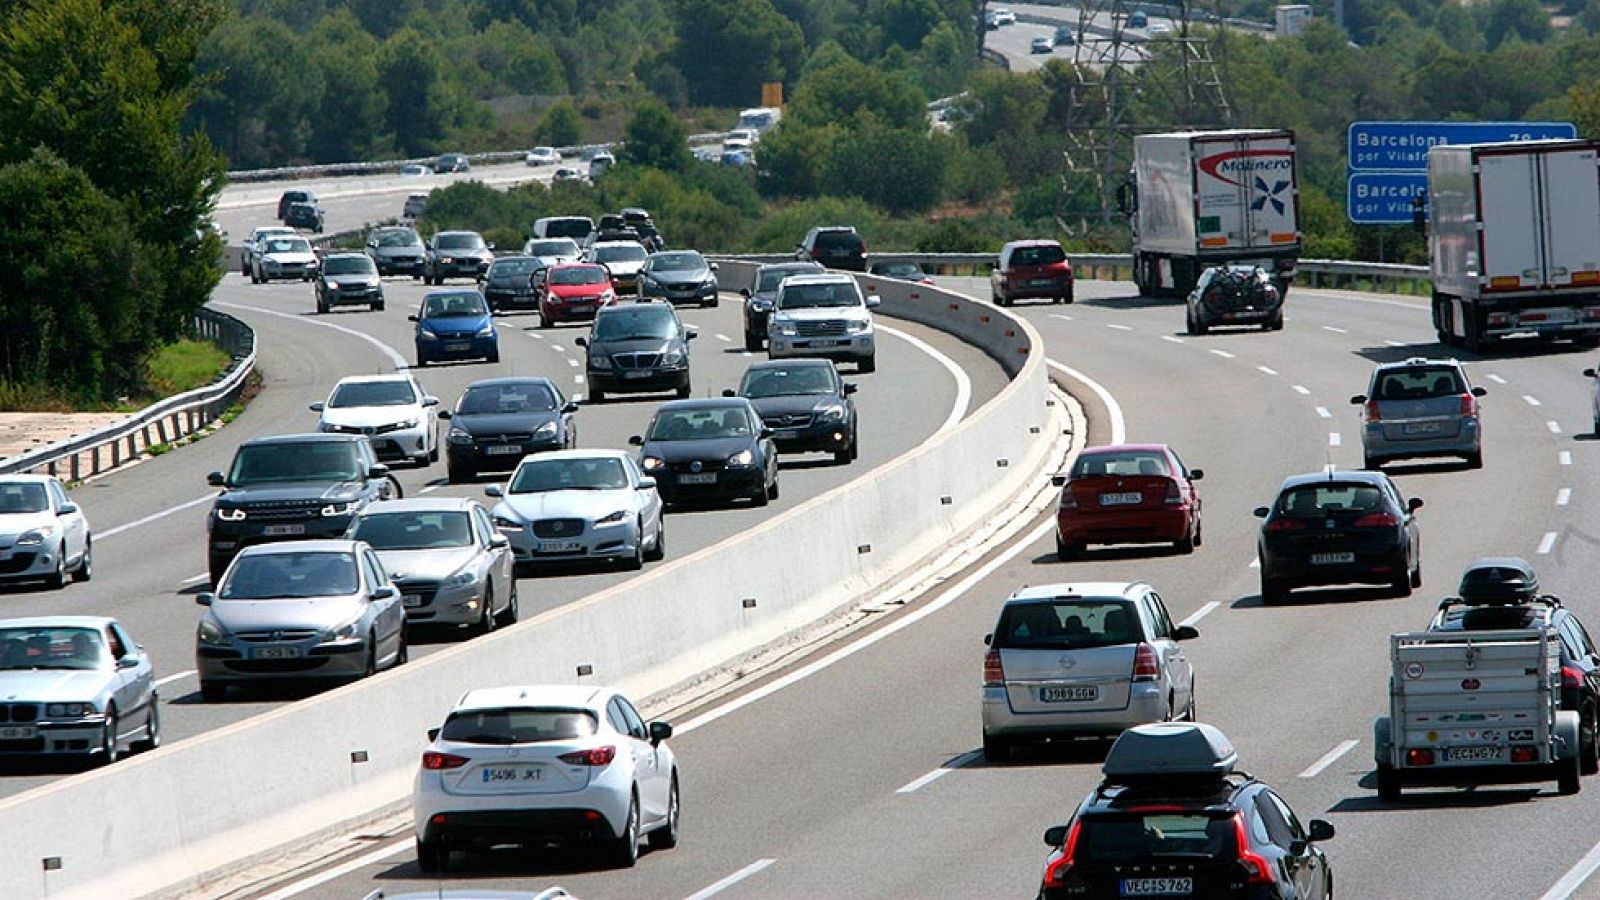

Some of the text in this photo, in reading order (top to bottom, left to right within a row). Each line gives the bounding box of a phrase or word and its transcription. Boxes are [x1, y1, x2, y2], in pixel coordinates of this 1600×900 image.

[1357, 133, 1448, 146] Barcelona
[1357, 152, 1379, 162] por
[1221, 159, 1292, 172] Molinero
[1356, 203, 1379, 213] por
[1126, 879, 1150, 893] VEC
[1168, 878, 1191, 892] 762
